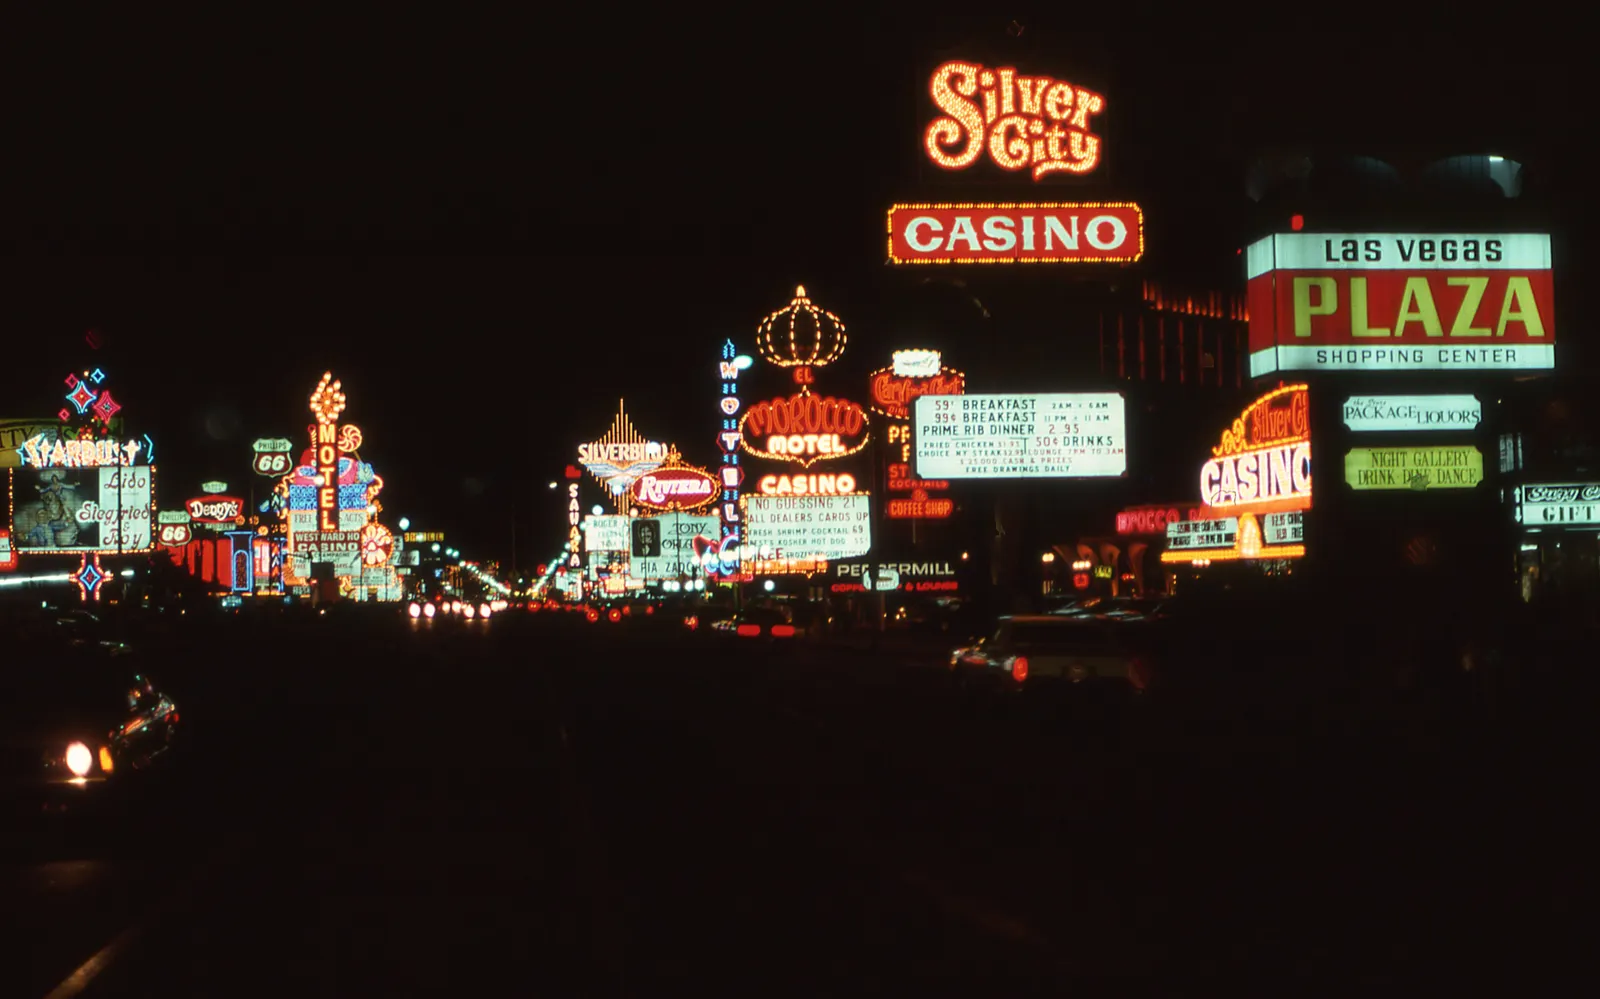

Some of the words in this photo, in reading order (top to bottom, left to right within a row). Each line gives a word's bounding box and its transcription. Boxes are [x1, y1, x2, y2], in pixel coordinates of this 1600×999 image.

[925, 60, 1104, 168] Silver
[988, 115, 1100, 180] City
[904, 215, 1128, 252] CASINO
[1293, 276, 1545, 337] PLAZA
[1317, 350, 1424, 364] SHOPPING
[1438, 349, 1517, 363] CENTER
[794, 371, 813, 382] EL
[963, 399, 1036, 411] BREAKFAST
[749, 395, 861, 435] MOROCCO
[935, 412, 956, 423] 99¢
[963, 412, 1036, 423] BREAKFAST
[1252, 400, 1292, 444] Silver
[1345, 405, 1417, 420] PACKAGE
[1417, 409, 1480, 425] LIQUORS
[923, 426, 960, 436] PRIME
[964, 425, 985, 435] RIB
[990, 424, 1035, 435] DINNER
[768, 434, 845, 454] MOTEL
[955, 441, 994, 449] CHICKEN
[1063, 435, 1114, 447] DRINKS
[918, 450, 950, 458] CHOICE
[972, 449, 1001, 457] STEAK
[1041, 456, 1073, 464] PRIZES
[1371, 452, 1408, 468] NIGHT
[1413, 450, 1471, 466] GALLERY
[258, 455, 286, 471] 66
[993, 465, 1040, 473] DRAWINGS
[104, 471, 146, 489] Lido
[319, 424, 336, 530] MOTEL
[1200, 443, 1311, 506] CASINO
[1358, 469, 1395, 486] DRINK
[1437, 468, 1477, 484] DANCE
[761, 474, 855, 494] CASINO
[189, 500, 239, 521] Denny's
[755, 498, 770, 510] NO
[776, 497, 834, 510] GUESSING
[890, 501, 924, 516] COFFEE
[925, 500, 951, 516] SHOP
[749, 514, 765, 523] ALL
[770, 513, 813, 523] DEALERS
[818, 512, 851, 522] CARDS
[856, 511, 869, 521] UP
[161, 526, 187, 541] 66
[777, 528, 807, 536] SHRIMP
[811, 527, 849, 535] COCKTAIL
[297, 542, 359, 552] CASINO
[778, 539, 808, 547] KOSHER
[837, 562, 955, 577] PEERMILL
